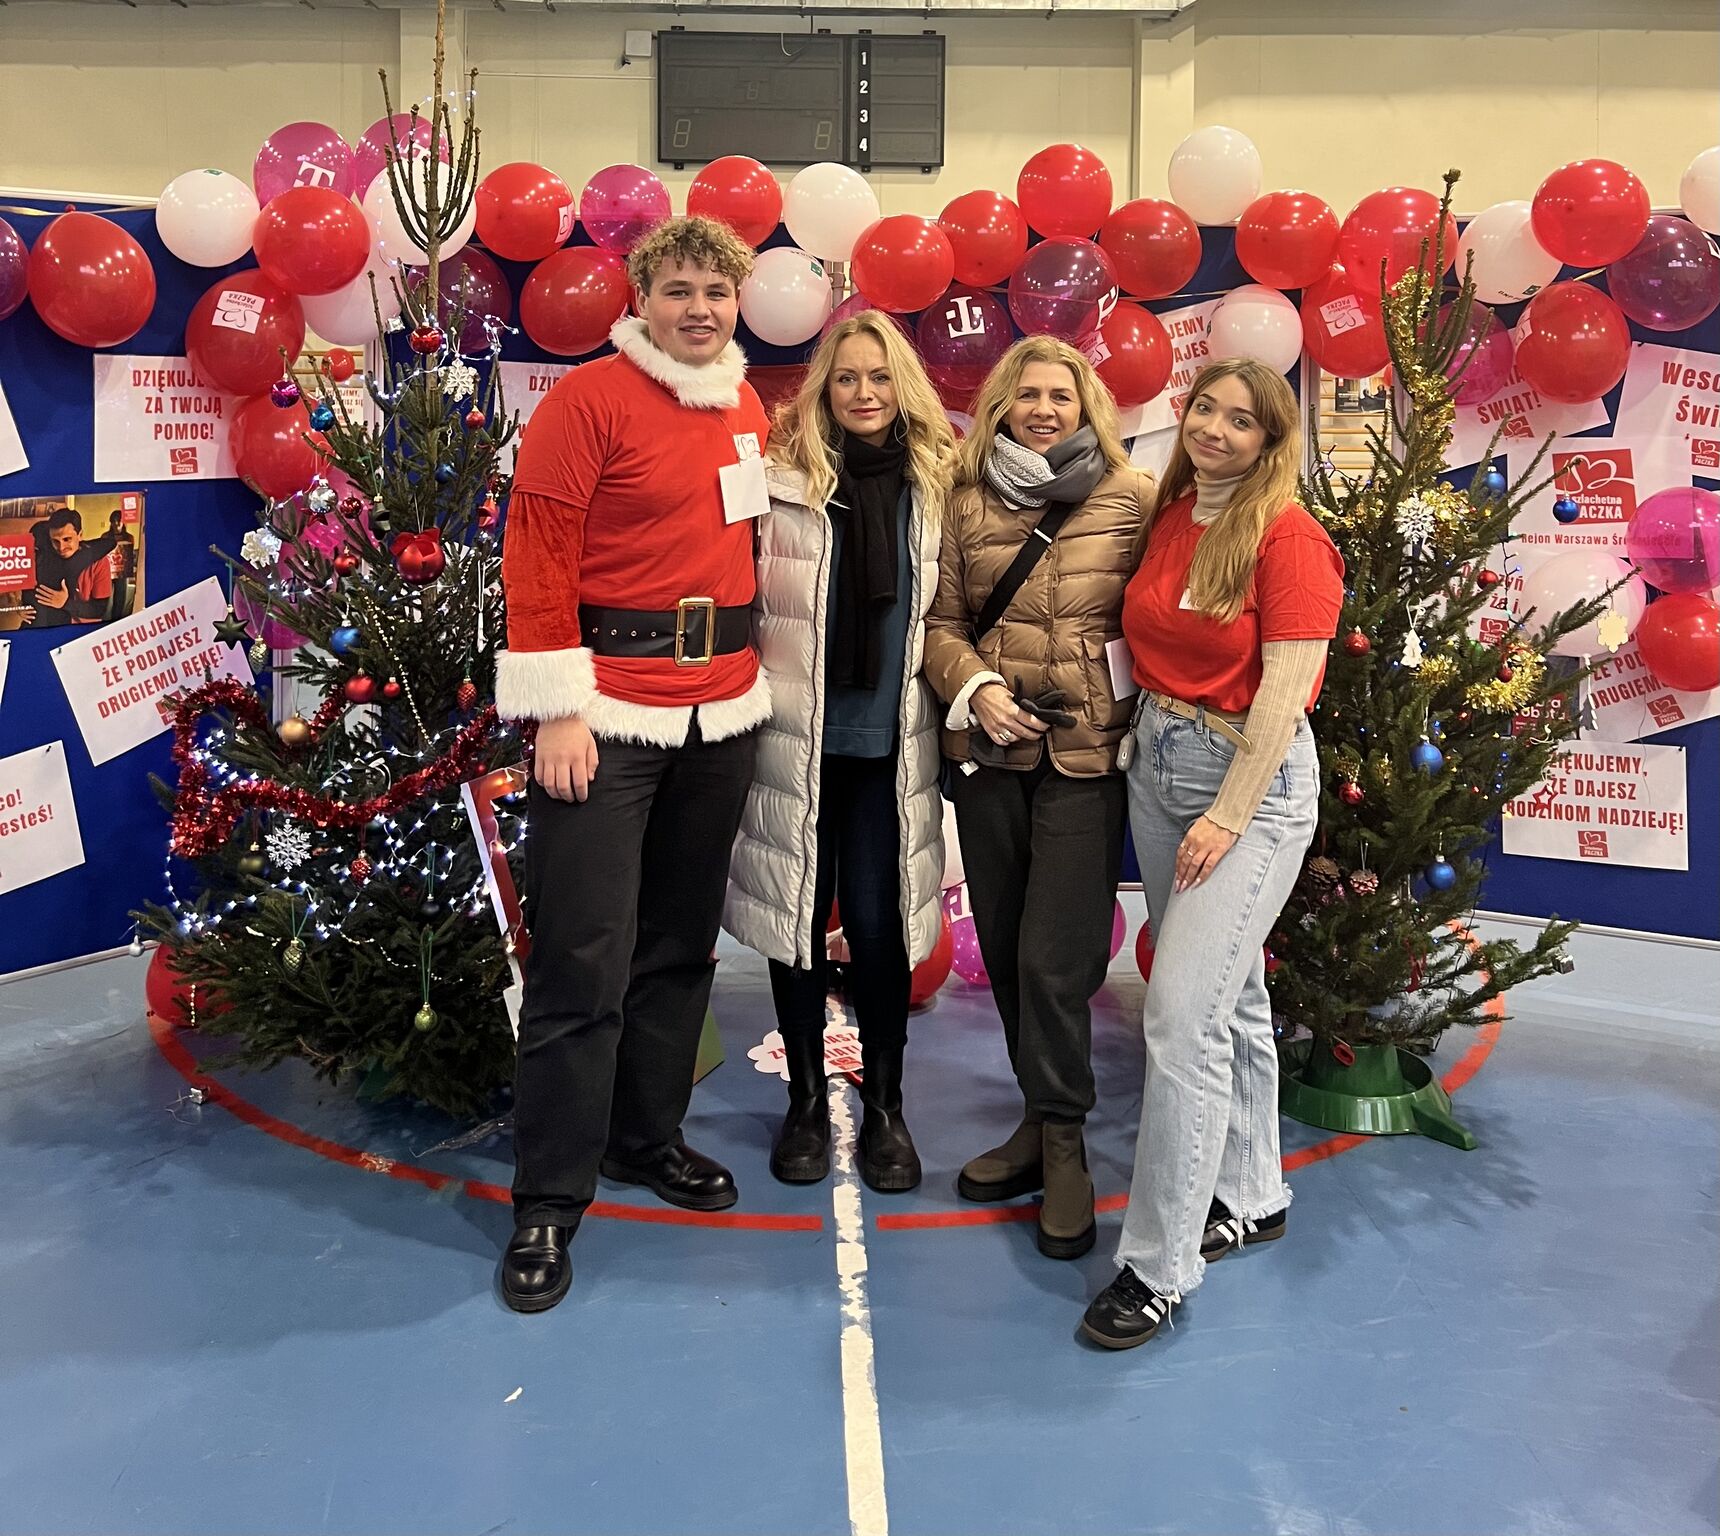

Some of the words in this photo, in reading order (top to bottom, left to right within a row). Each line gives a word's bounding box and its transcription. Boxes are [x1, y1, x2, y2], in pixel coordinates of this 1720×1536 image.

[861, 52, 867, 65] 1
[860, 80, 868, 94] 2
[860, 110, 868, 123] 3
[859, 138, 868, 151] 4
[529, 375, 560, 392] DZI
[145, 397, 163, 414] ZA
[170, 396, 222, 419] TWOJĄ
[1477, 390, 1542, 425] ŚWIAT!
[154, 422, 214, 441] POMOC!
[1571, 494, 1622, 505] szlachetna
[1579, 505, 1623, 519] ACZKA
[1521, 533, 1550, 544] Rejon
[1554, 533, 1608, 546] Warszawa
[92, 605, 195, 663] DZIĘKUJEMY,
[102, 665, 123, 688] ŻE
[125, 627, 202, 676] PODAJESZ
[97, 667, 178, 718] DRUGIEMU
[181, 645, 224, 677] RĘKĘ!
[1591, 674, 1671, 709] RUGIEM
[1549, 752, 1648, 777] IĘKUJEMY,
[1574, 779, 1636, 801] DAJESZ
[1598, 807, 1684, 836] NADZIEJĘ!
